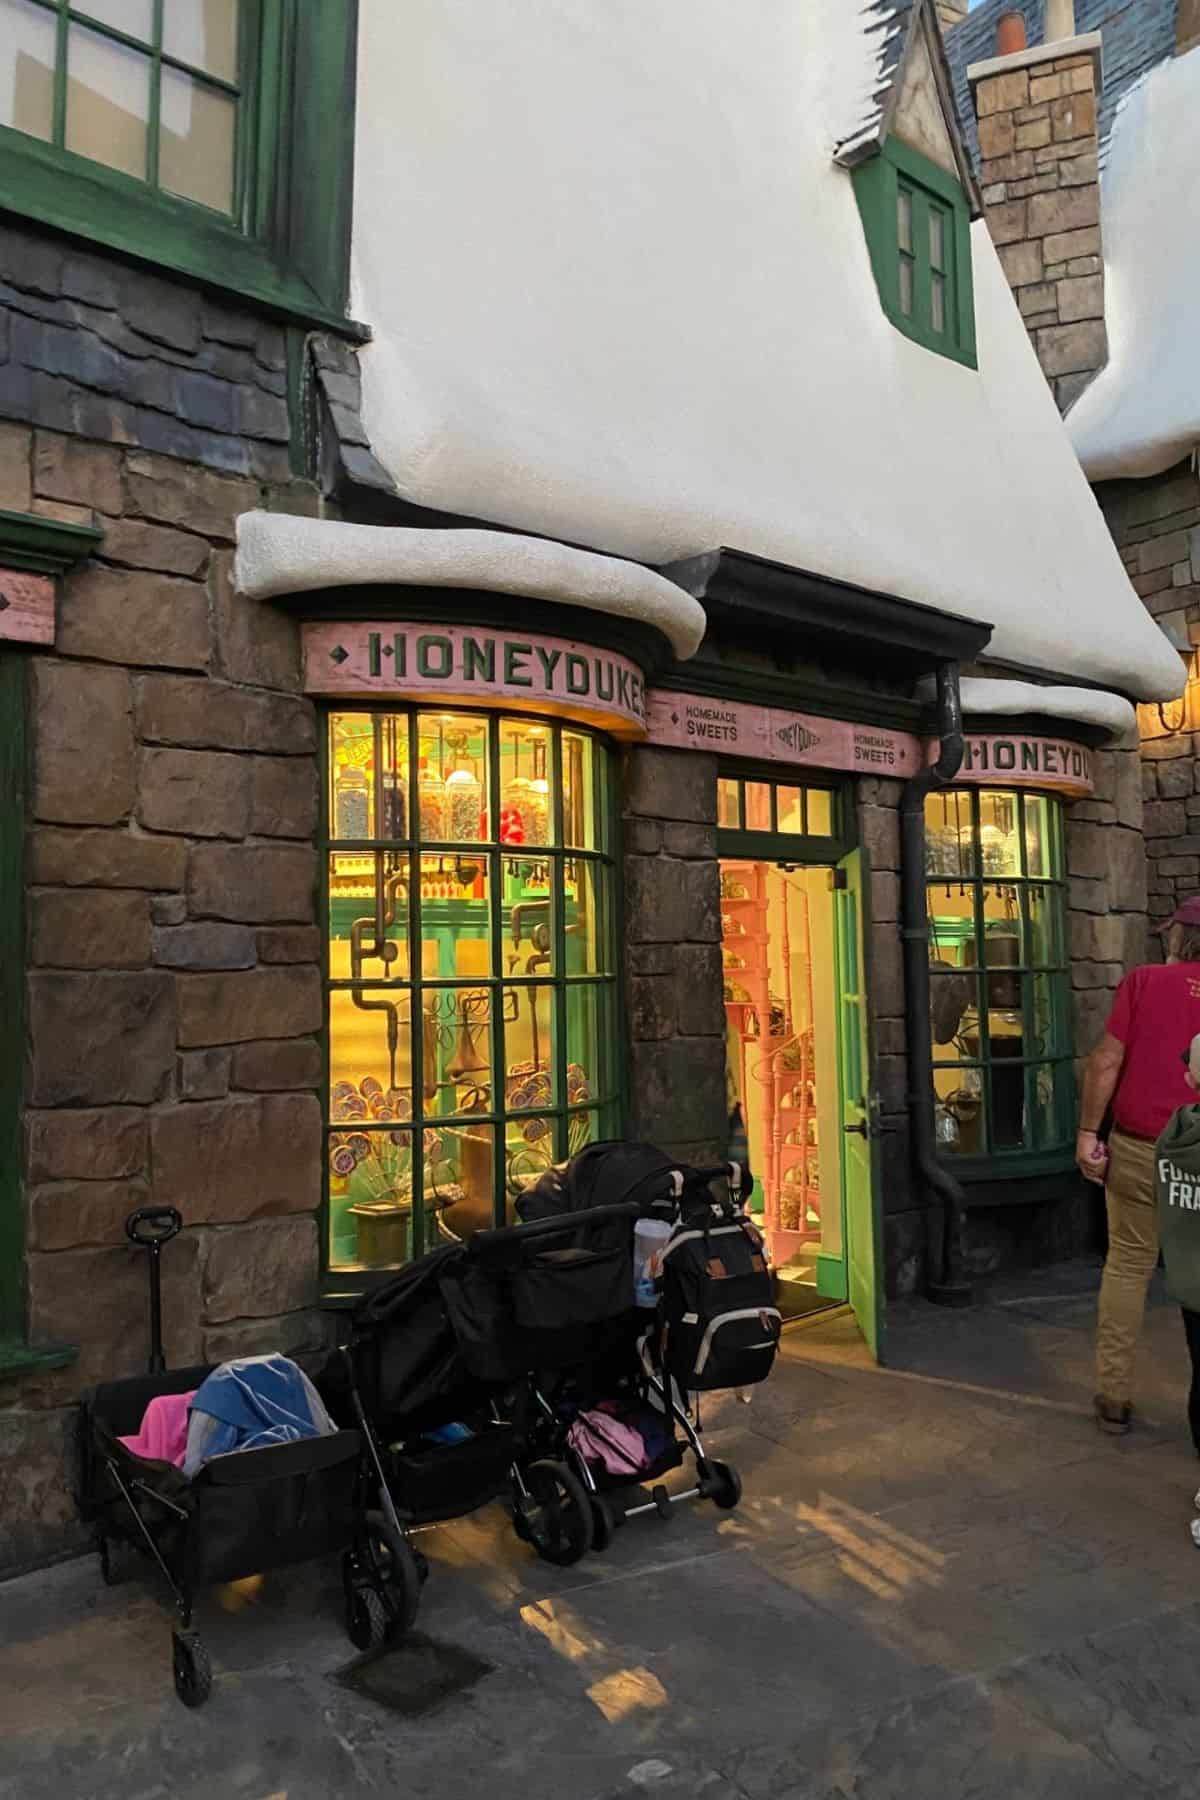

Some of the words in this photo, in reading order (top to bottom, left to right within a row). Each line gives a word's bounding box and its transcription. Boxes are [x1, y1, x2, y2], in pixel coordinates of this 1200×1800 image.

[686, 705, 737, 724] HOMEMADE
[687, 723, 738, 741] SWEETS
[854, 735, 895, 750] HOMEMADE
[855, 747, 896, 765] SWEETS
